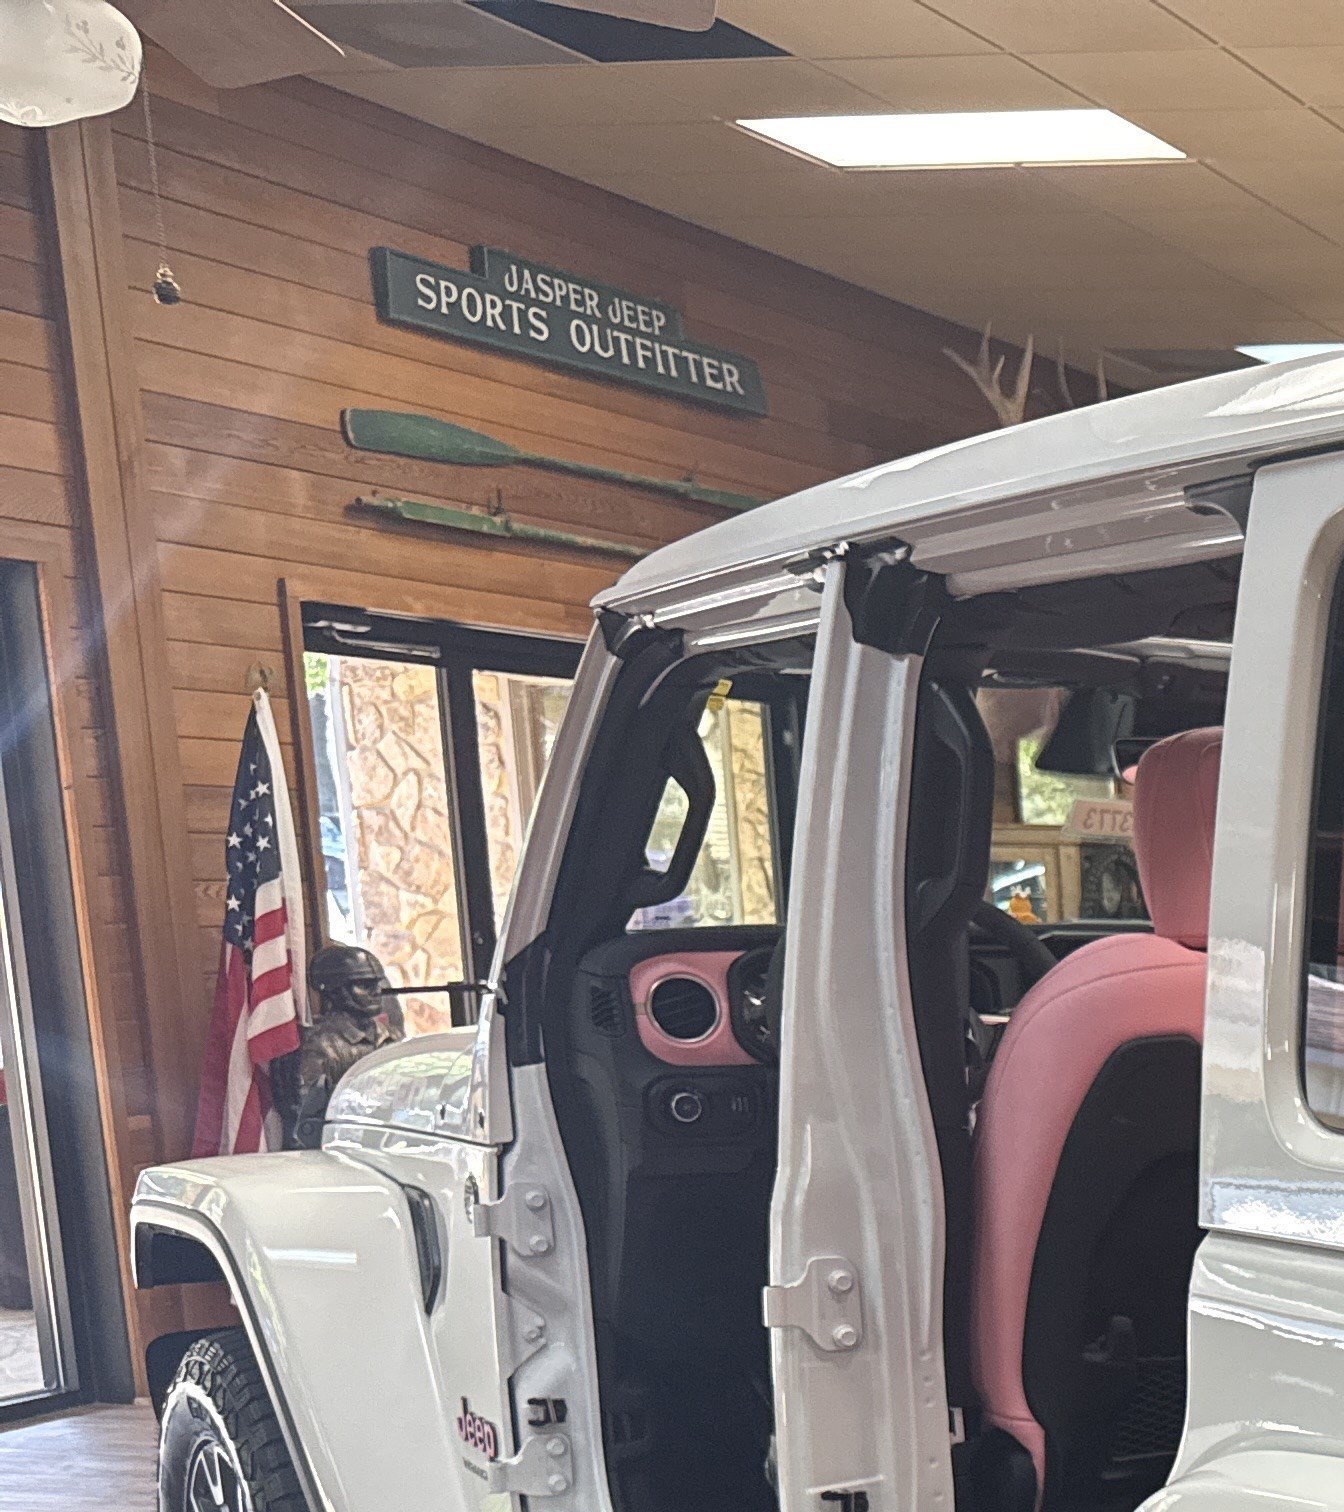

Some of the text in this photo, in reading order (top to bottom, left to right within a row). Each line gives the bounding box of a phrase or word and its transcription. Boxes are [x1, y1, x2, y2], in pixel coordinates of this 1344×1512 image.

[415, 274, 745, 396] SPORTS OUTFITTER
[503, 264, 666, 336] JASPER JEEP
[457, 1396, 498, 1462] Jeep
